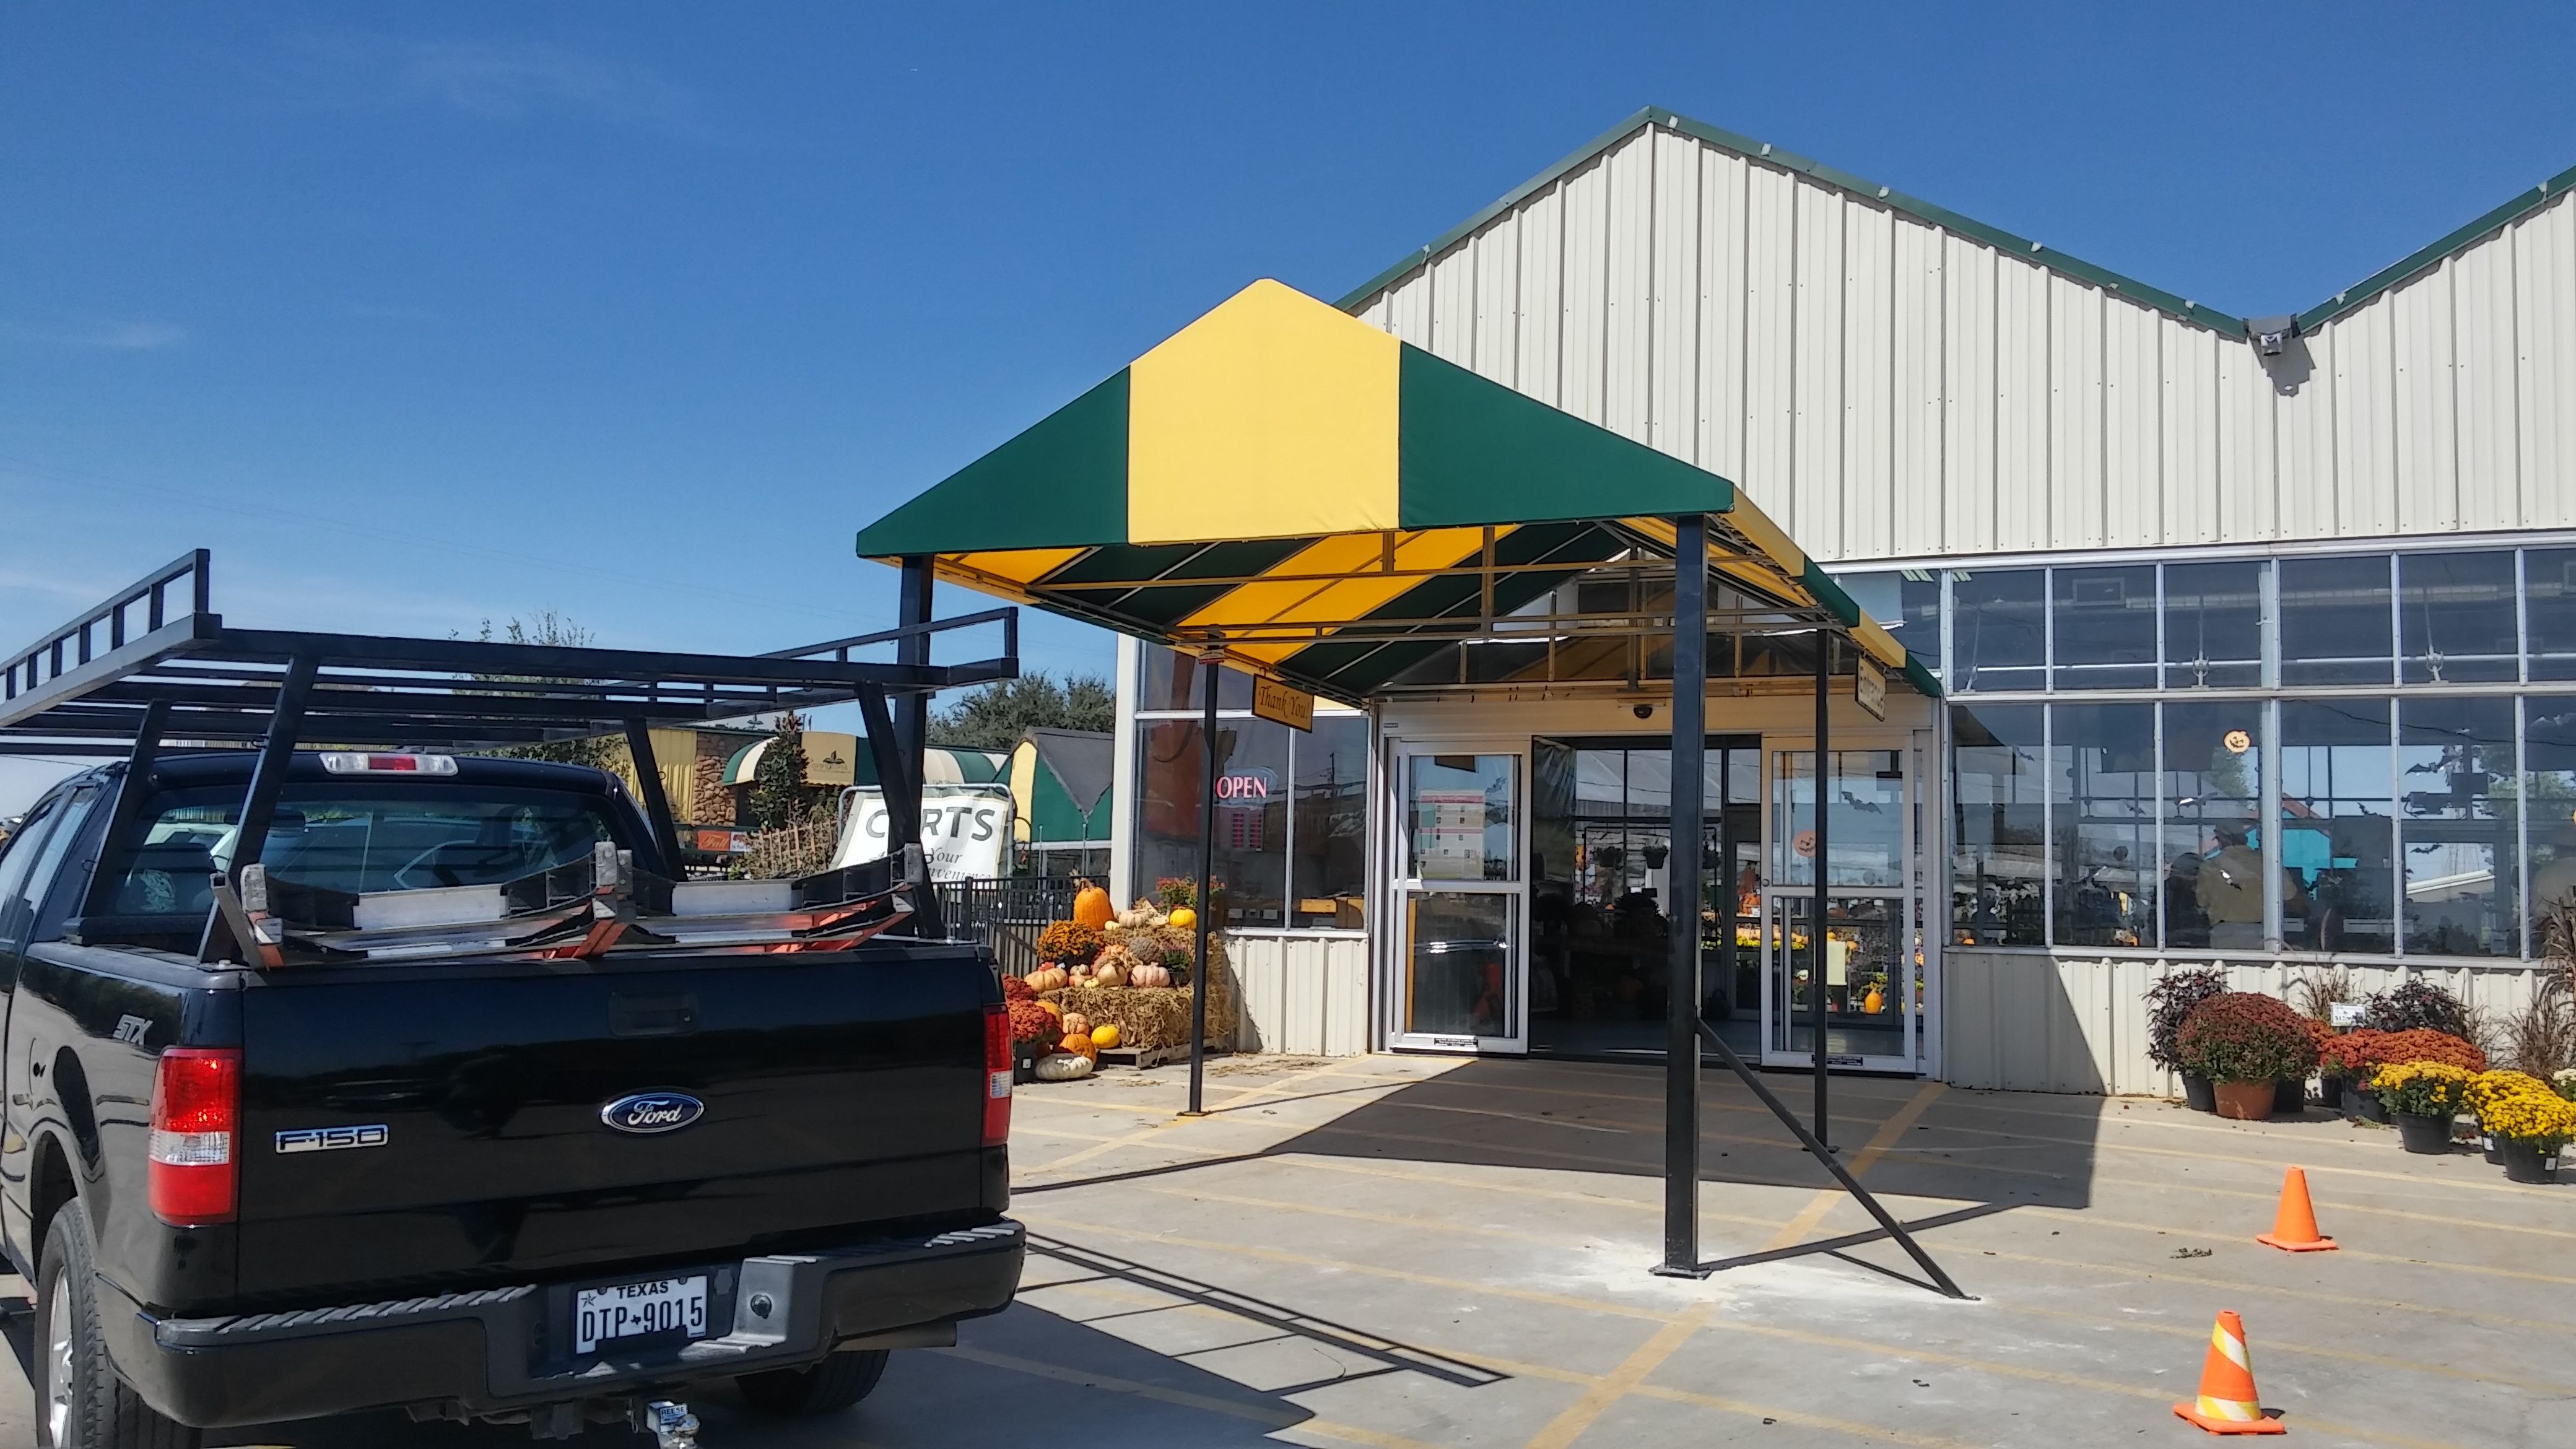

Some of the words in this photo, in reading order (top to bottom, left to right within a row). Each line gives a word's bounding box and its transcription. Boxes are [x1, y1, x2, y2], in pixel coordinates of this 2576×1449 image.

[1259, 685, 1288, 718] Thank
[1290, 696, 1310, 719] You!
[1216, 776, 1268, 799] OPEN
[866, 806, 996, 842] CRTS
[701, 833, 729, 848] Fall
[931, 846, 963, 864] Your
[113, 1014, 154, 1045] STX
[627, 1099, 683, 1126] Ford
[279, 1127, 385, 1151] F-150
[617, 1281, 669, 1299] TEXAS
[582, 1306, 627, 1342] DTP
[643, 1296, 702, 1332] 9015
[661, 1406, 685, 1416] REESE
